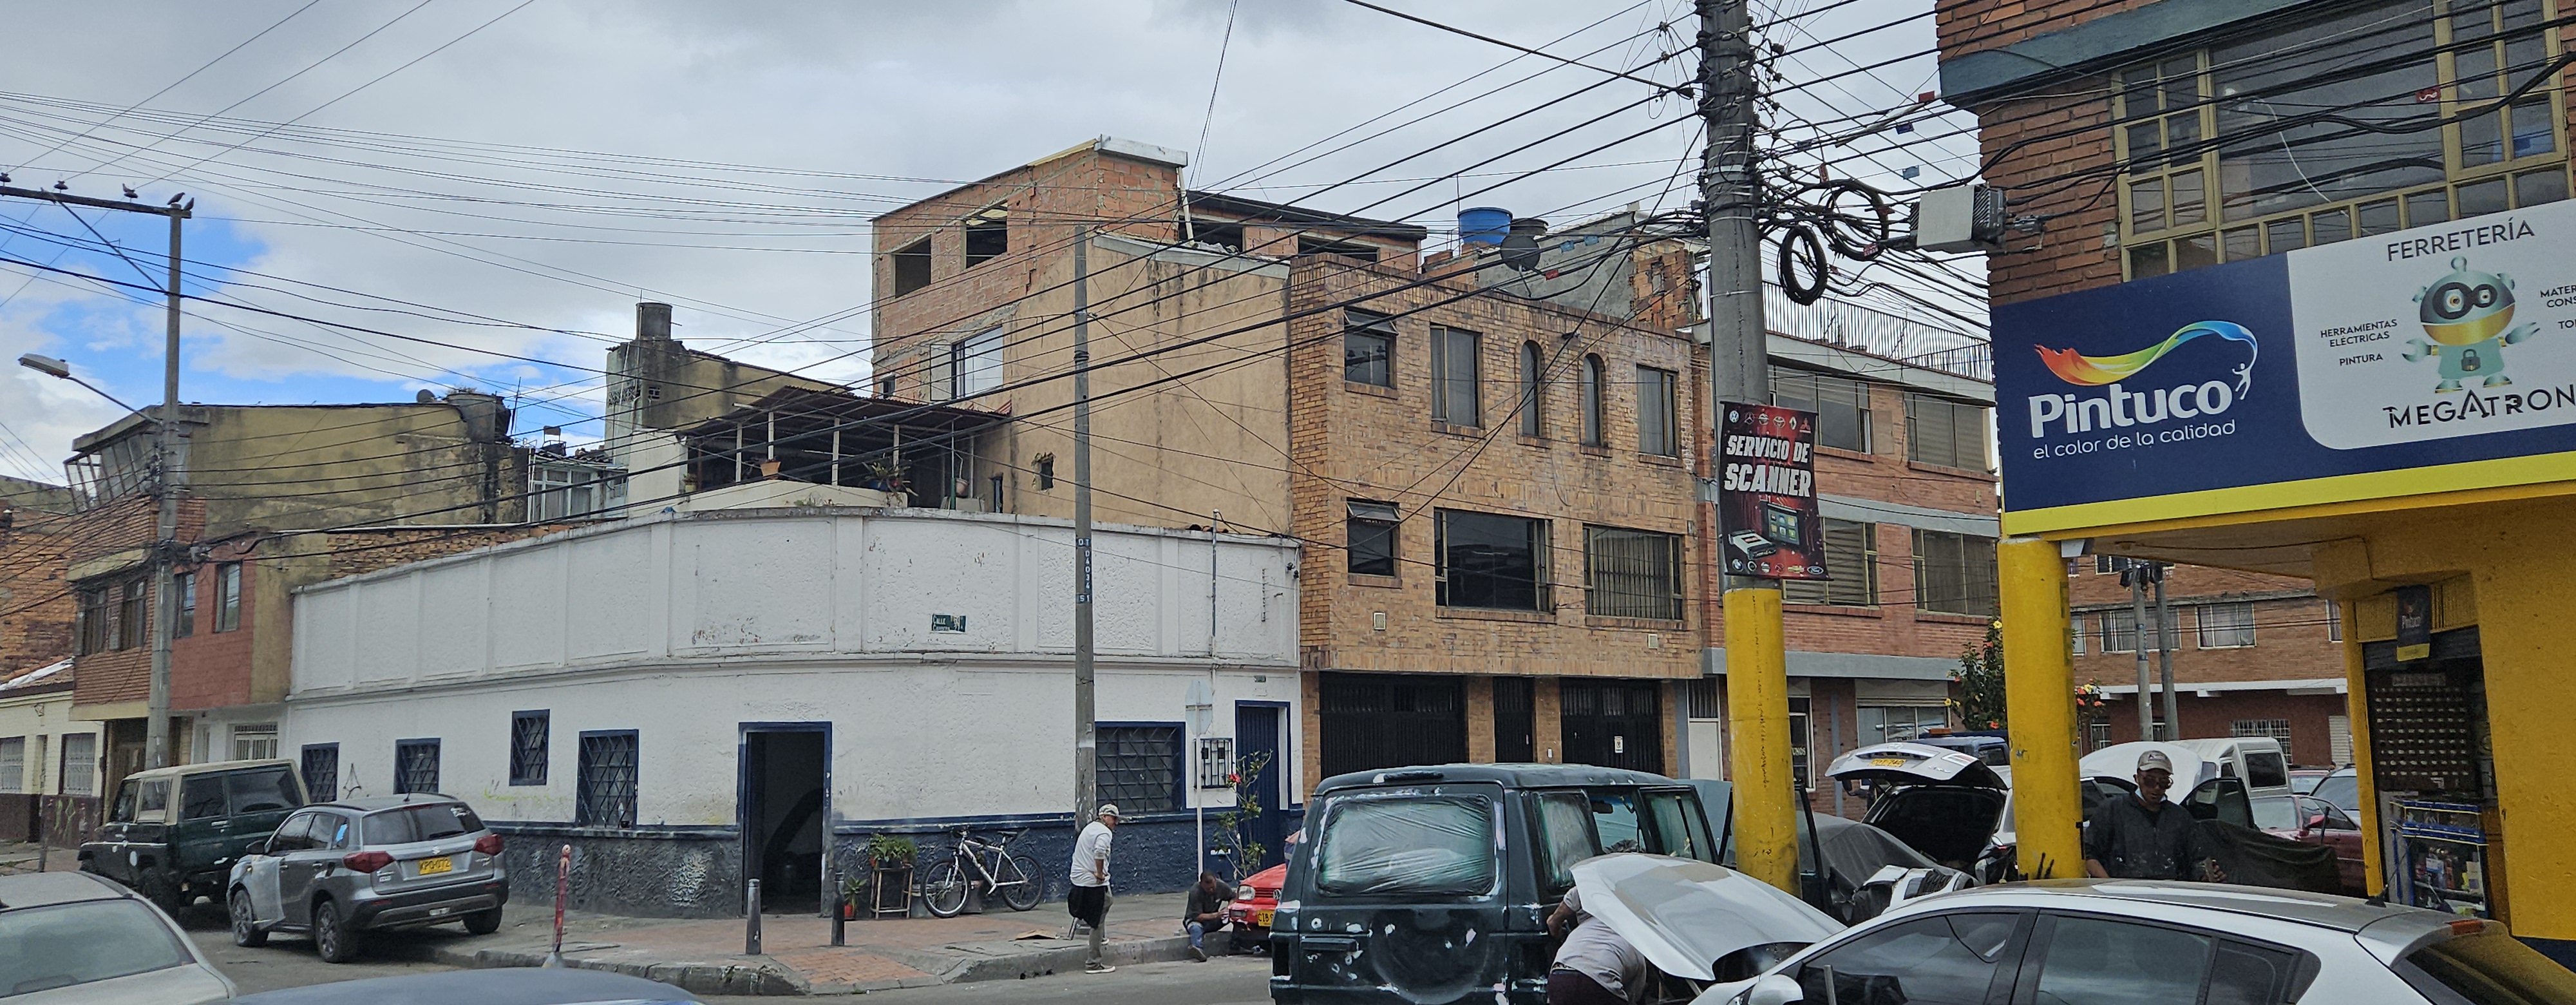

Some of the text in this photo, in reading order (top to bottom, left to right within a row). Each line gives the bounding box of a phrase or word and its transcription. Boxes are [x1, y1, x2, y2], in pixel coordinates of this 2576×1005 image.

[2387, 217, 2535, 261] FERRETERÍA
[2540, 285, 2576, 298] MATER
[2320, 319, 2398, 338] HERRAMIENTAS
[2557, 319, 2576, 329] TO
[2329, 331, 2390, 347] ELÉCTRICAS
[2339, 353, 2383, 366] PINTURA
[2029, 380, 2233, 438] Pintuco
[2383, 384, 2576, 428] MEGATRON
[1726, 435, 1811, 463] SERVICIO DE
[2034, 419, 2236, 459] el color de la calidad
[1724, 463, 1812, 497] SCANNER
